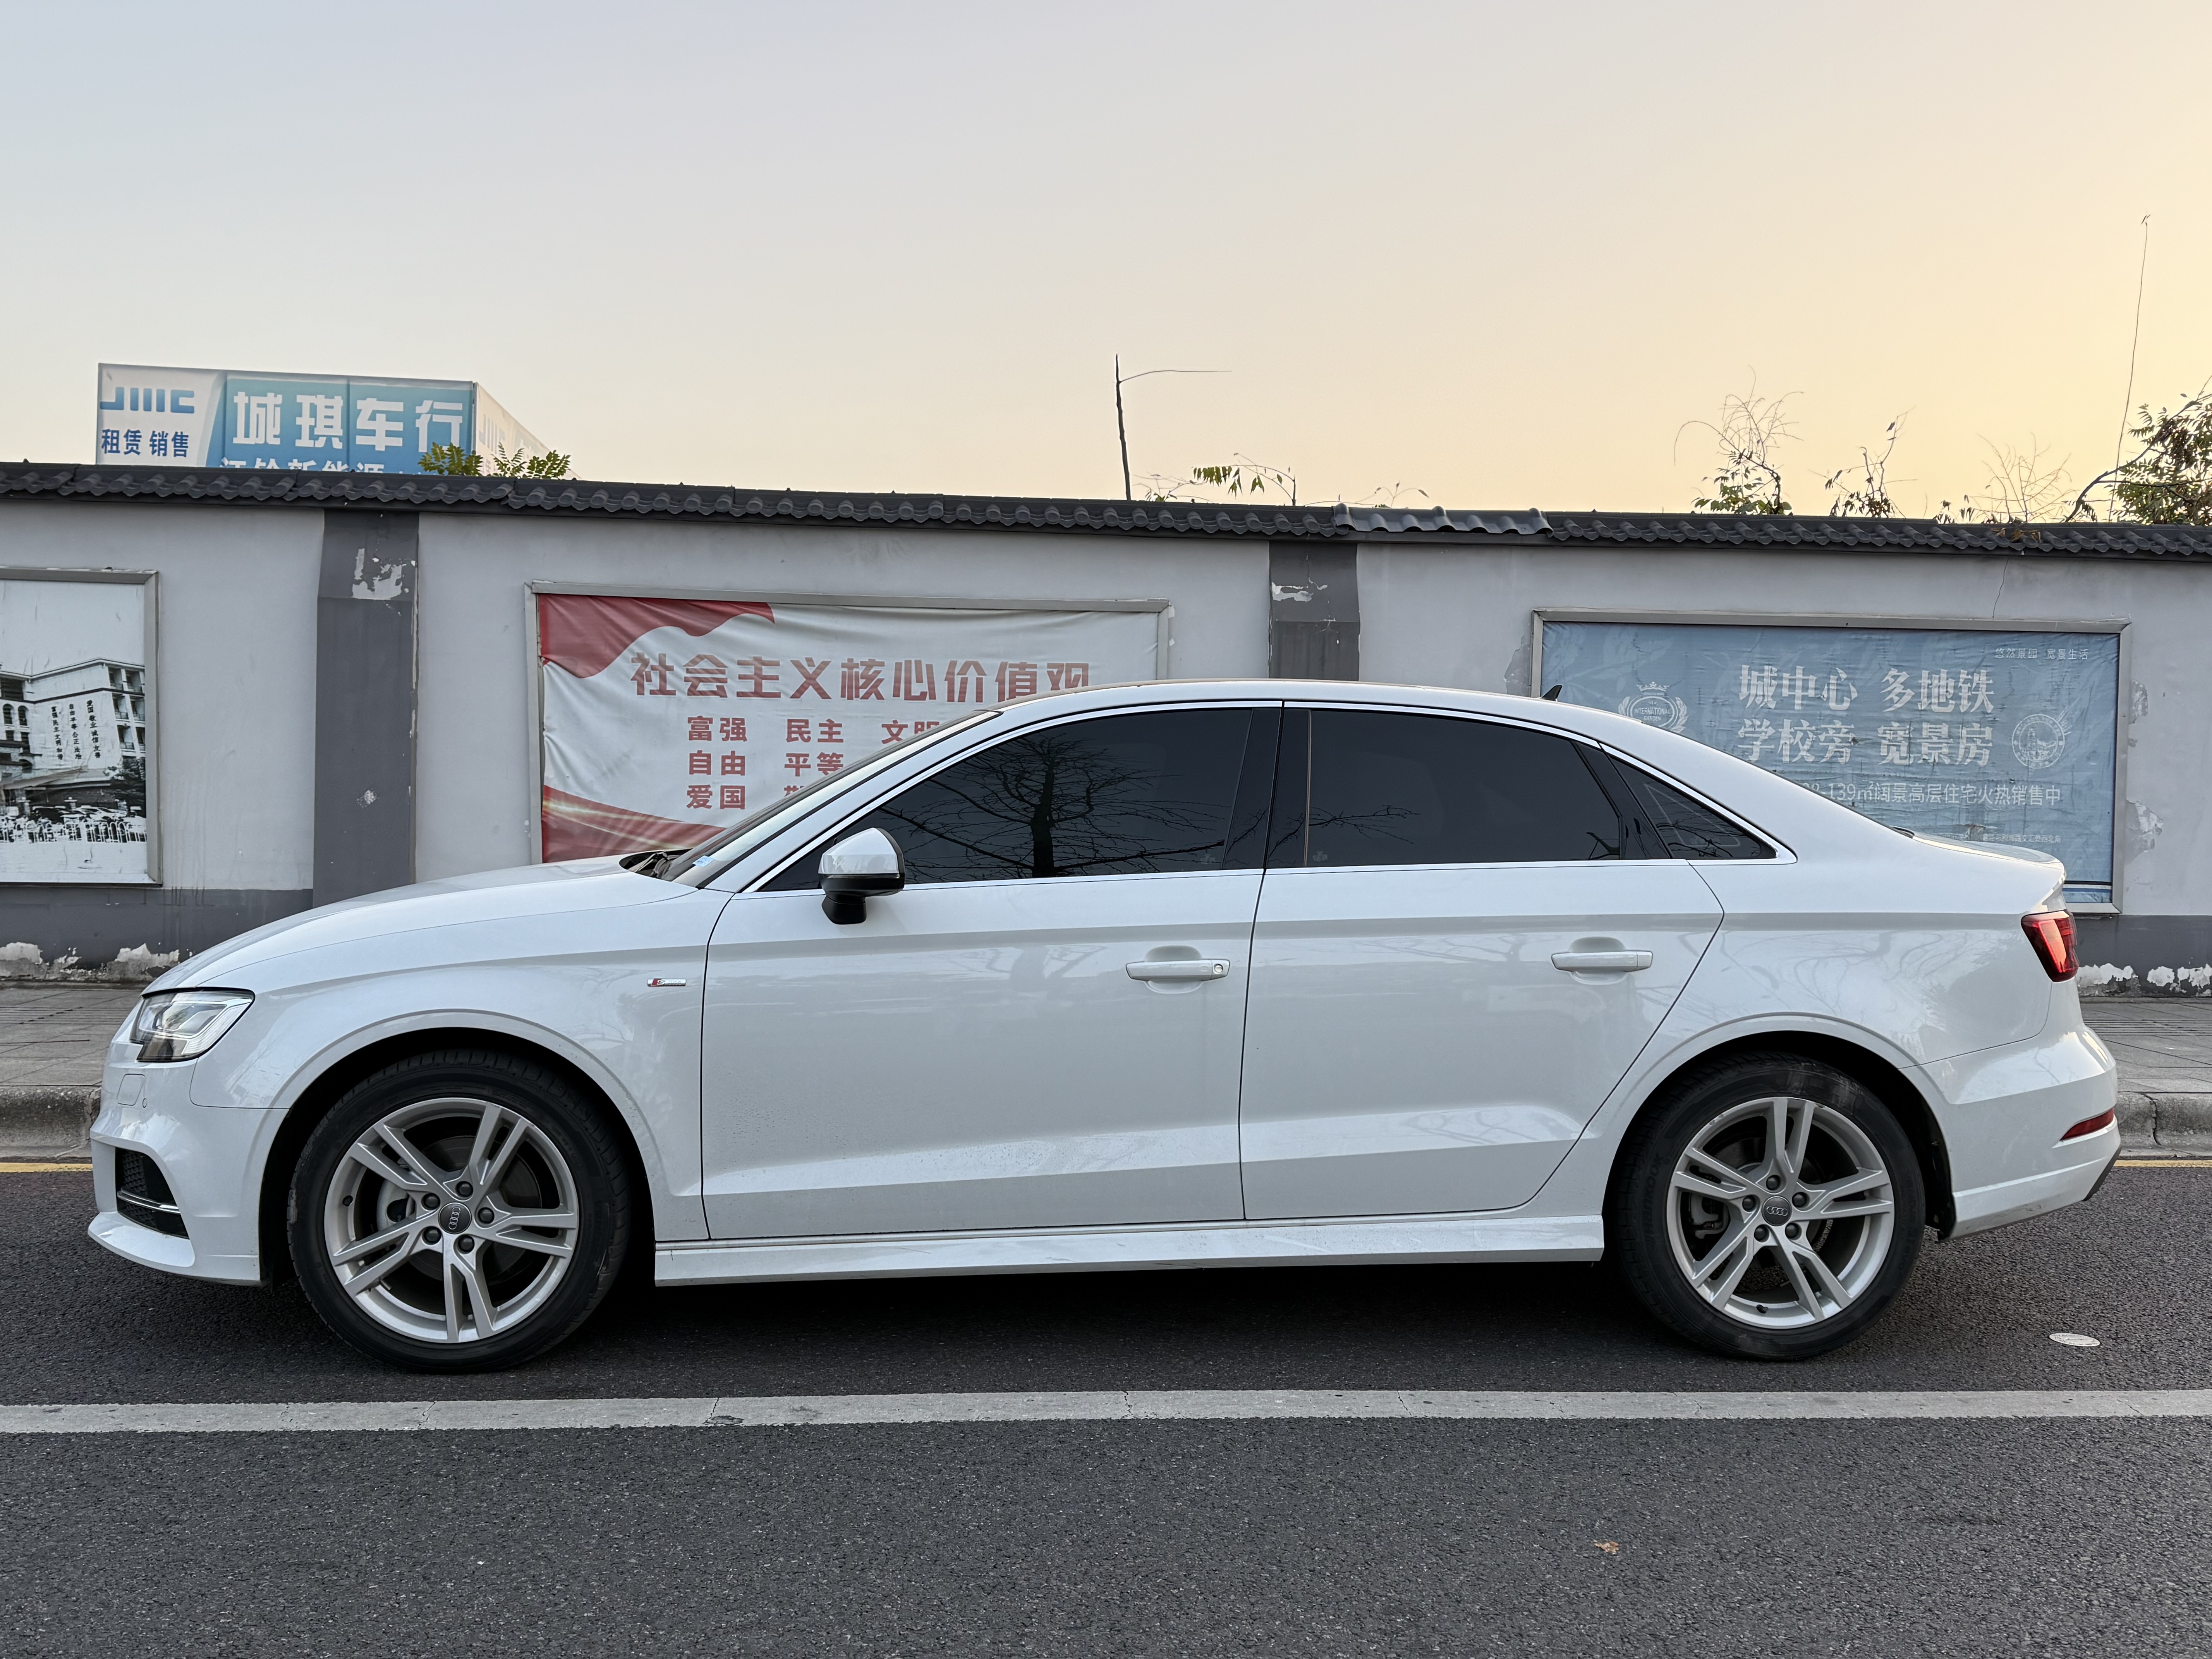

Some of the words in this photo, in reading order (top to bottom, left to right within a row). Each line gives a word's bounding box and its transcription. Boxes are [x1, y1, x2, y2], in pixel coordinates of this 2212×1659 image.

[233, 392, 463, 453] 城琪车行
[101, 428, 142, 455] 租赁
[149, 430, 189, 458] 销售
[1995, 648, 2038, 659] 悠然景园
[2047, 649, 2088, 659] 宽景生活
[630, 652, 1089, 702] 社会主义核心价值观
[1739, 665, 1858, 710] 城中心
[1880, 668, 1994, 713] 多地铁
[1634, 707, 1671, 716] INTERNATIONAL
[687, 716, 747, 742] 富强
[786, 718, 844, 743] 民主
[1738, 719, 1855, 764] 学校旁
[1877, 721, 1993, 767] 宽景房
[689, 750, 745, 776] 自由
[785, 752, 844, 777] 平等
[687, 784, 745, 810] 爱国
